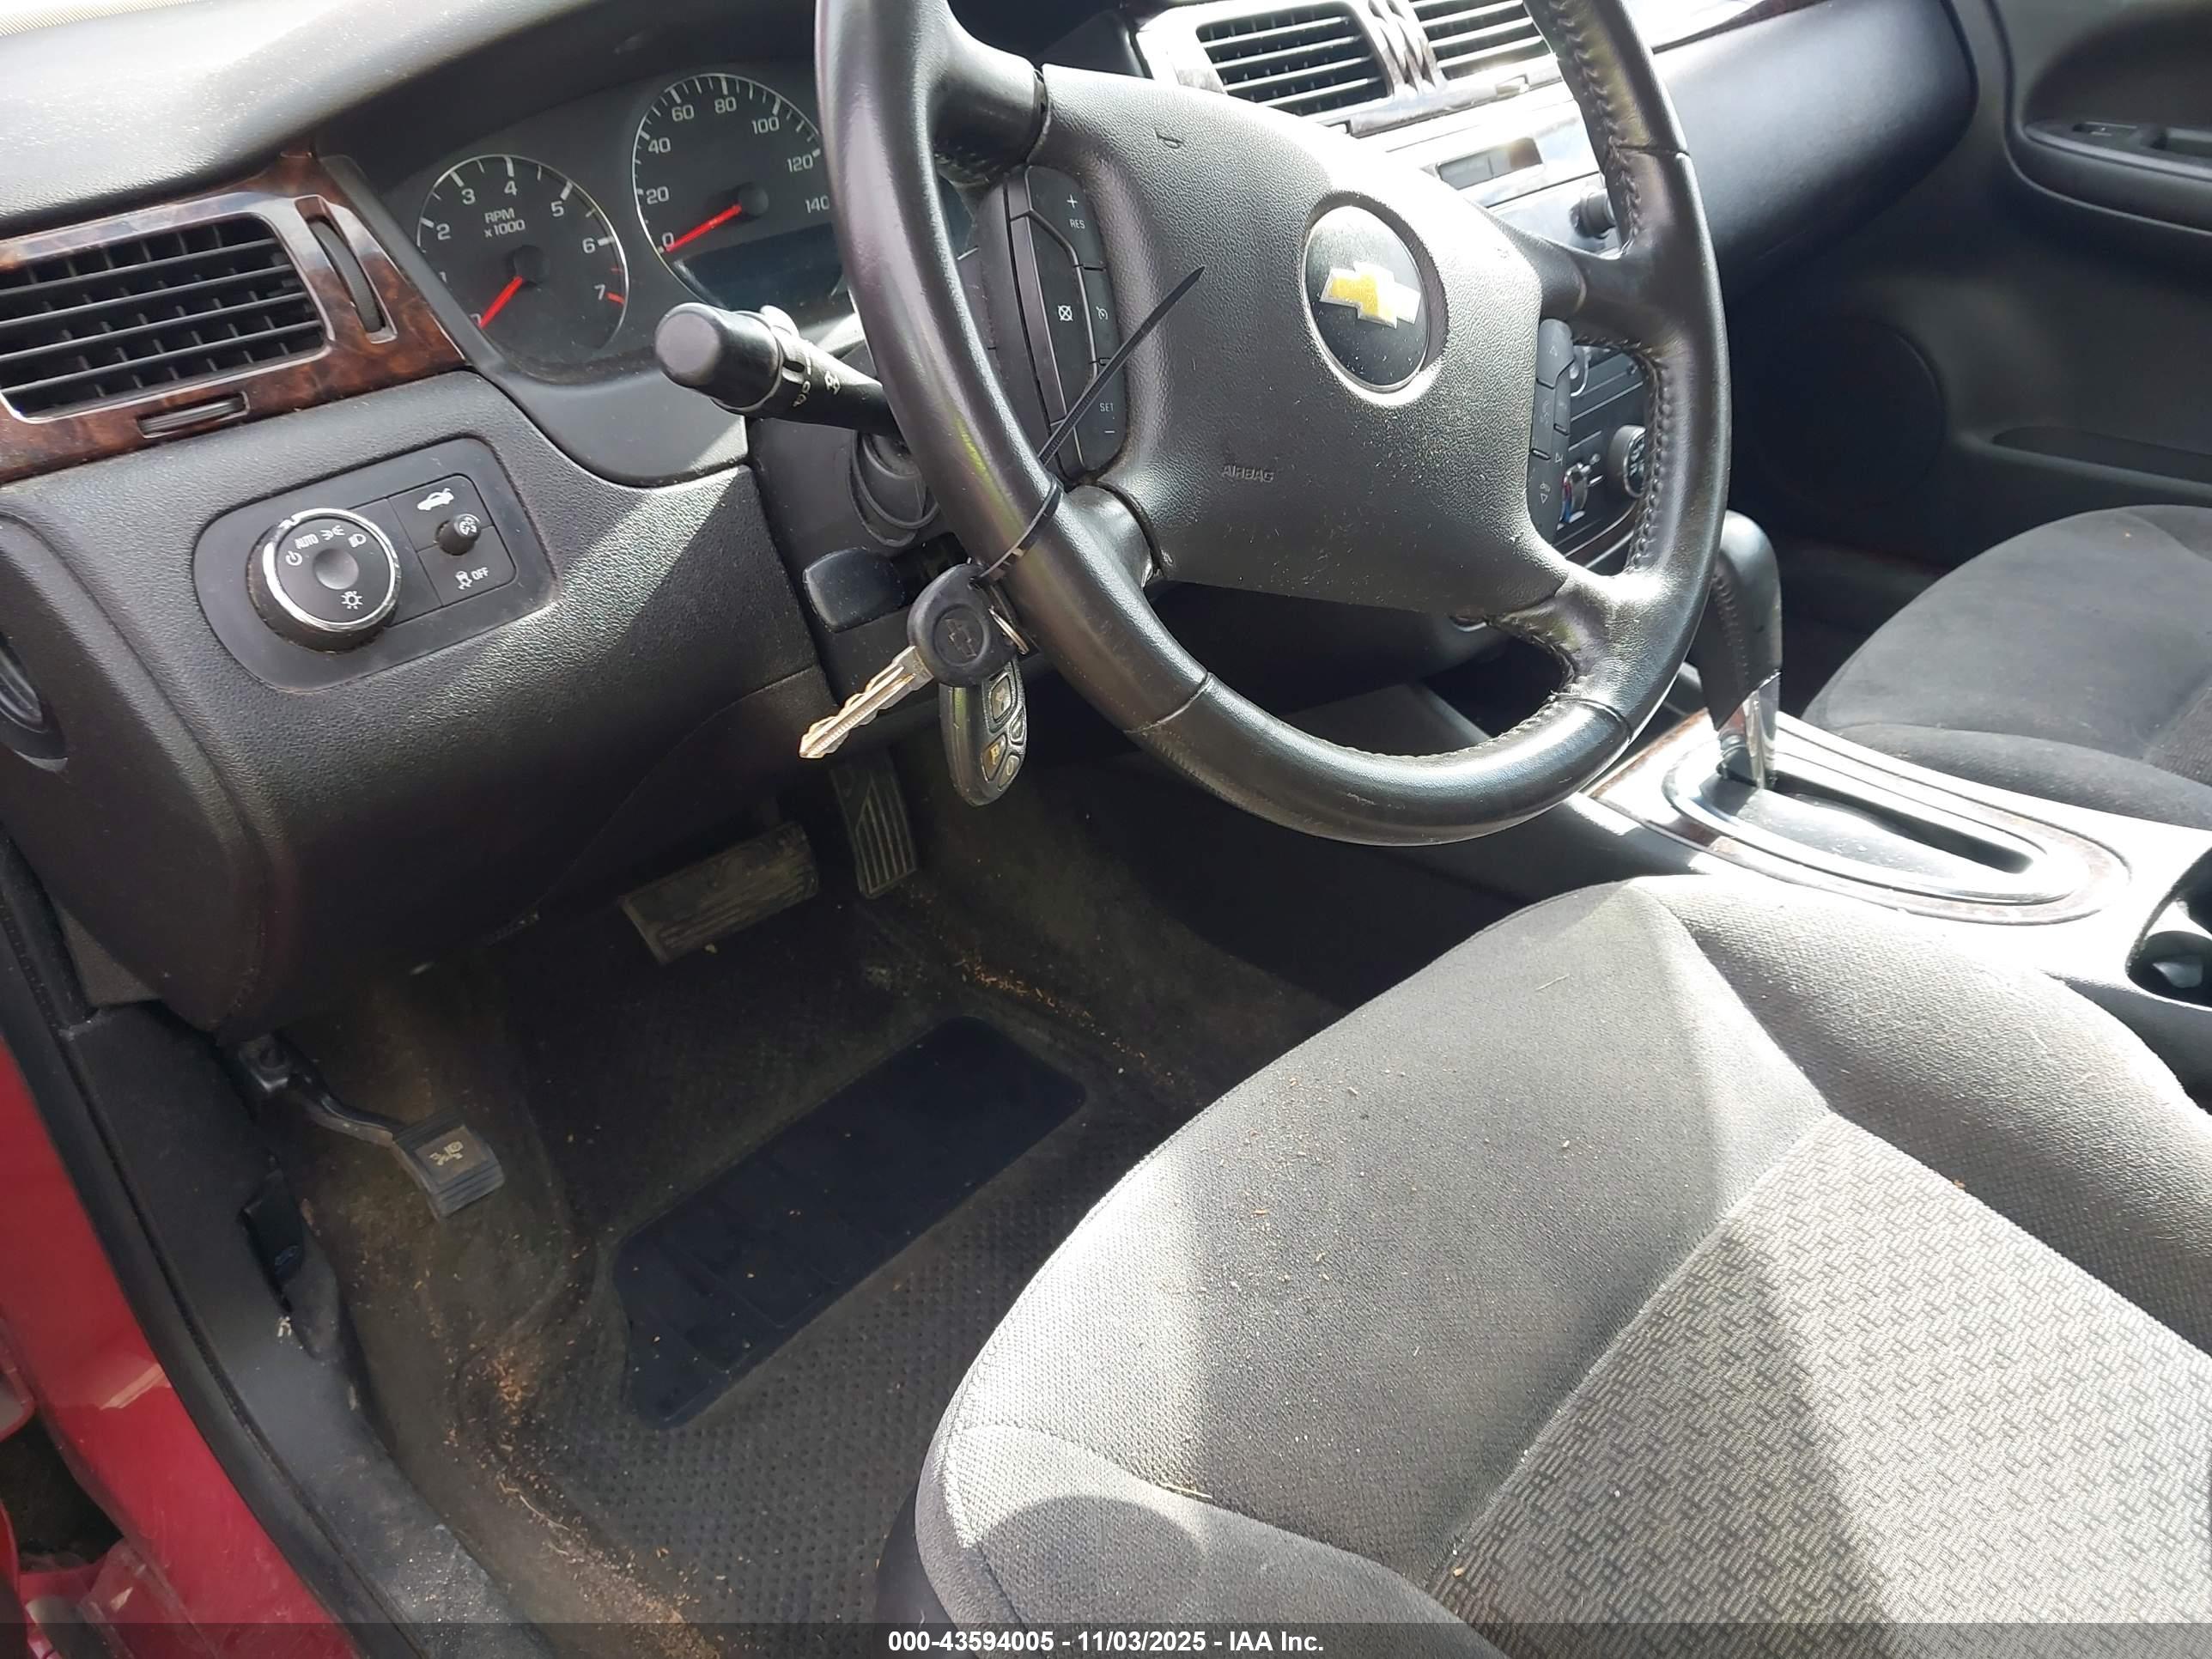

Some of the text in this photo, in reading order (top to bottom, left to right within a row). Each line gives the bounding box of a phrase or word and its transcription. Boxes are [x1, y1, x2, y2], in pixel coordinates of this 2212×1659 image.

[672, 105, 695, 122] 60
[714, 97, 737, 113] 80
[751, 117, 780, 135] 100
[648, 137, 672, 155] 40
[787, 155, 814, 173] 120
[461, 188, 476, 205] 3
[503, 180, 518, 196] 4
[646, 186, 670, 205] 20
[550, 200, 565, 217] 5
[805, 196, 830, 214] 140
[483, 207, 515, 224] RPM
[1069, 219, 1085, 229] RES
[436, 223, 451, 241] 2
[661, 232, 675, 248] 0
[581, 237, 596, 254] 6
[594, 283, 606, 301] 7
[1099, 402, 1114, 412] SET
[1222, 465, 1274, 483] AIRBAG
[295, 533, 319, 550] AUTO
[471, 567, 489, 580] OFF
